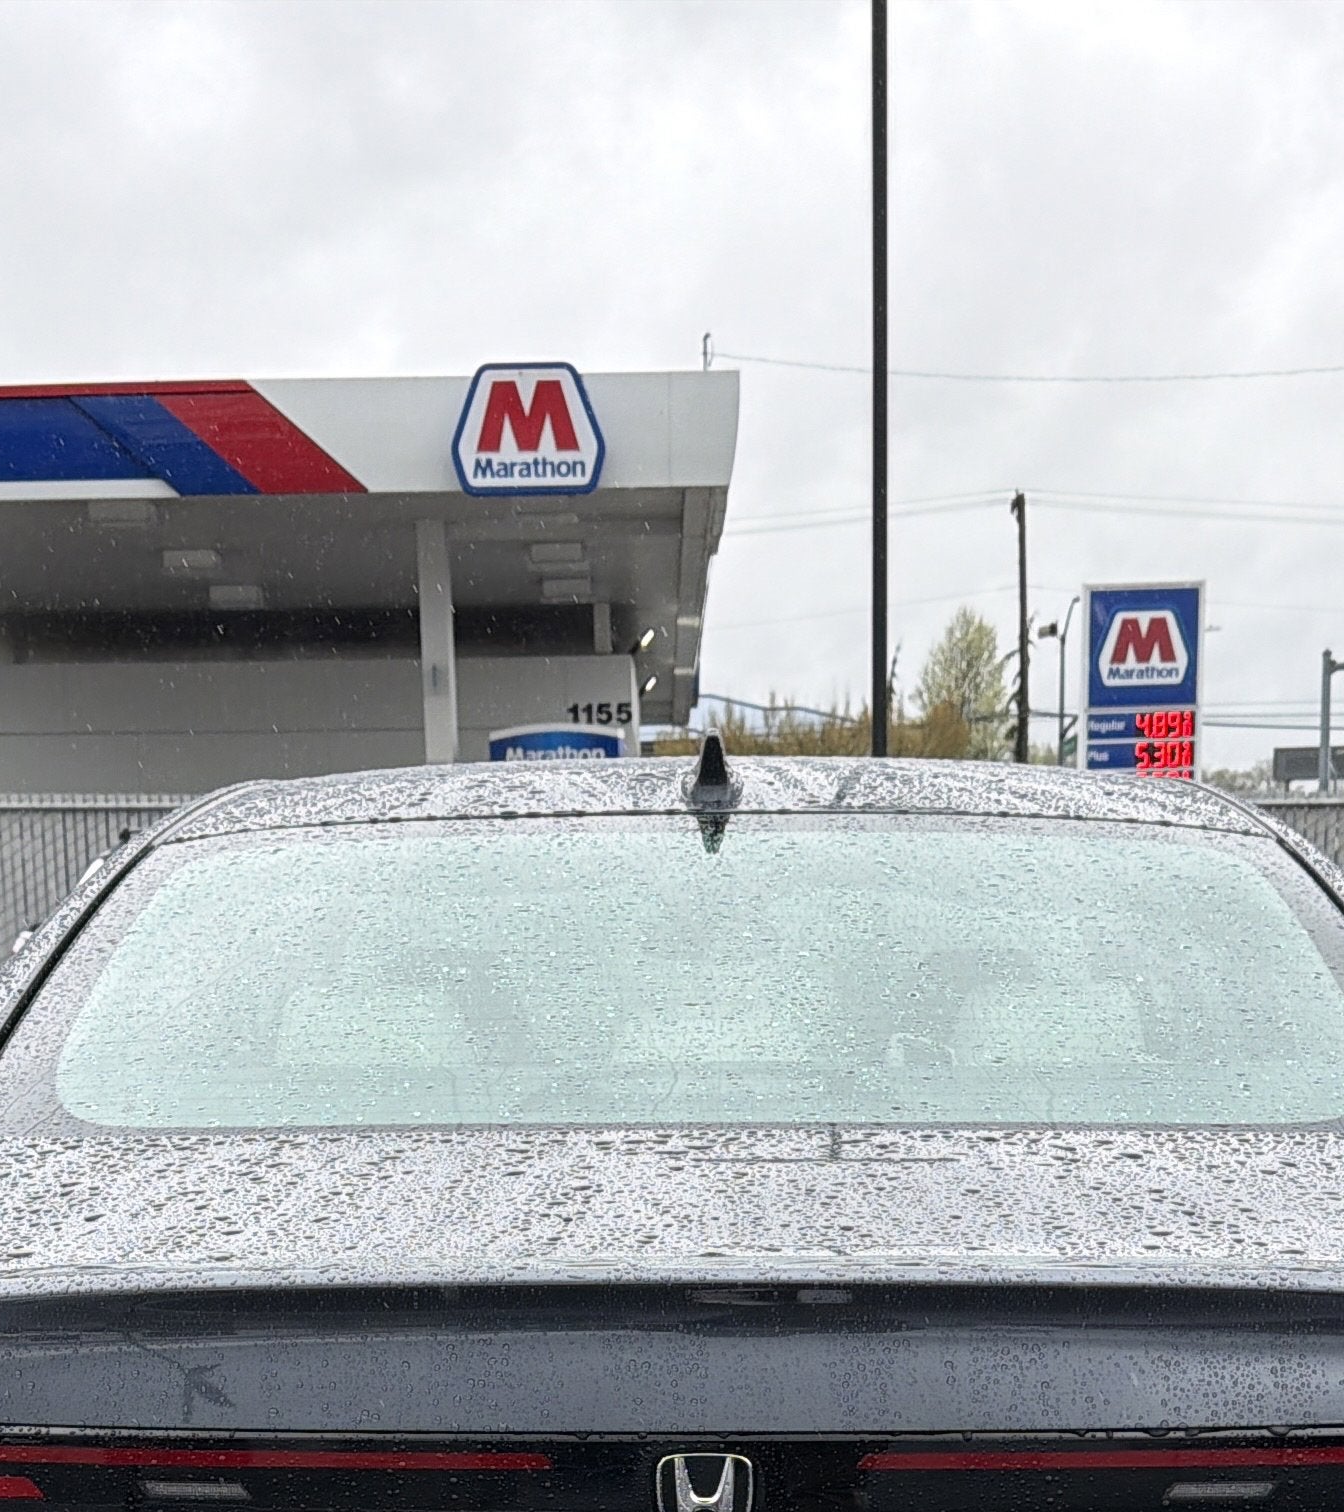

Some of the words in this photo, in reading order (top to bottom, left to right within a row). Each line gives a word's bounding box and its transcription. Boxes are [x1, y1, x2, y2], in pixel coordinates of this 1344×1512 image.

[473, 458, 586, 479] Marathon
[1107, 666, 1179, 680] Marathon
[567, 703, 632, 724] 1155
